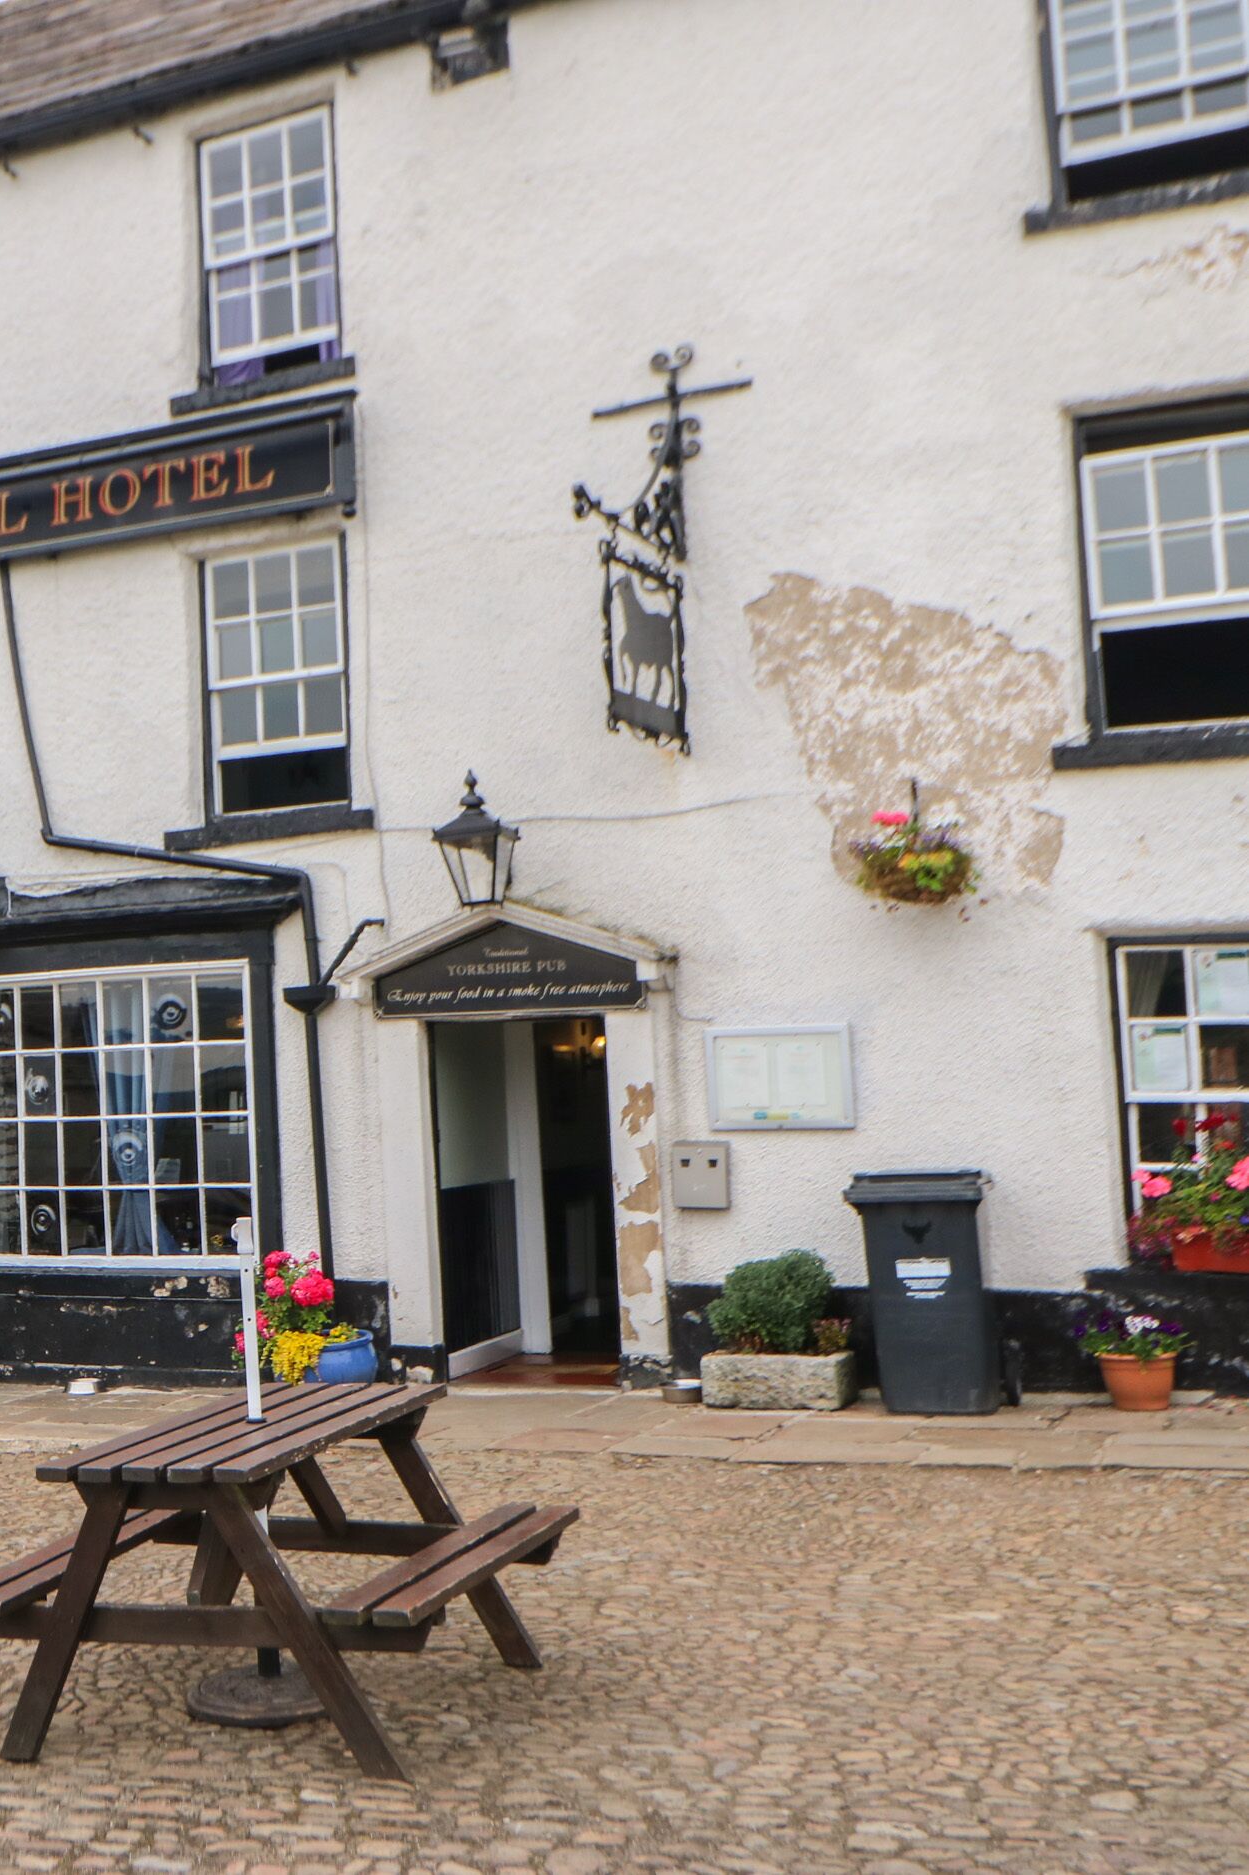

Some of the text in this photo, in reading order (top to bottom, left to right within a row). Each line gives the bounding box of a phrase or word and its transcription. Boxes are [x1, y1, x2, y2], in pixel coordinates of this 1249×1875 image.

[49, 444, 276, 526] HOTEL
[446, 959, 567, 976] YORKSHIRE PUB
[387, 980, 631, 1006] Enjoy your food in a smoke free atmosphere
